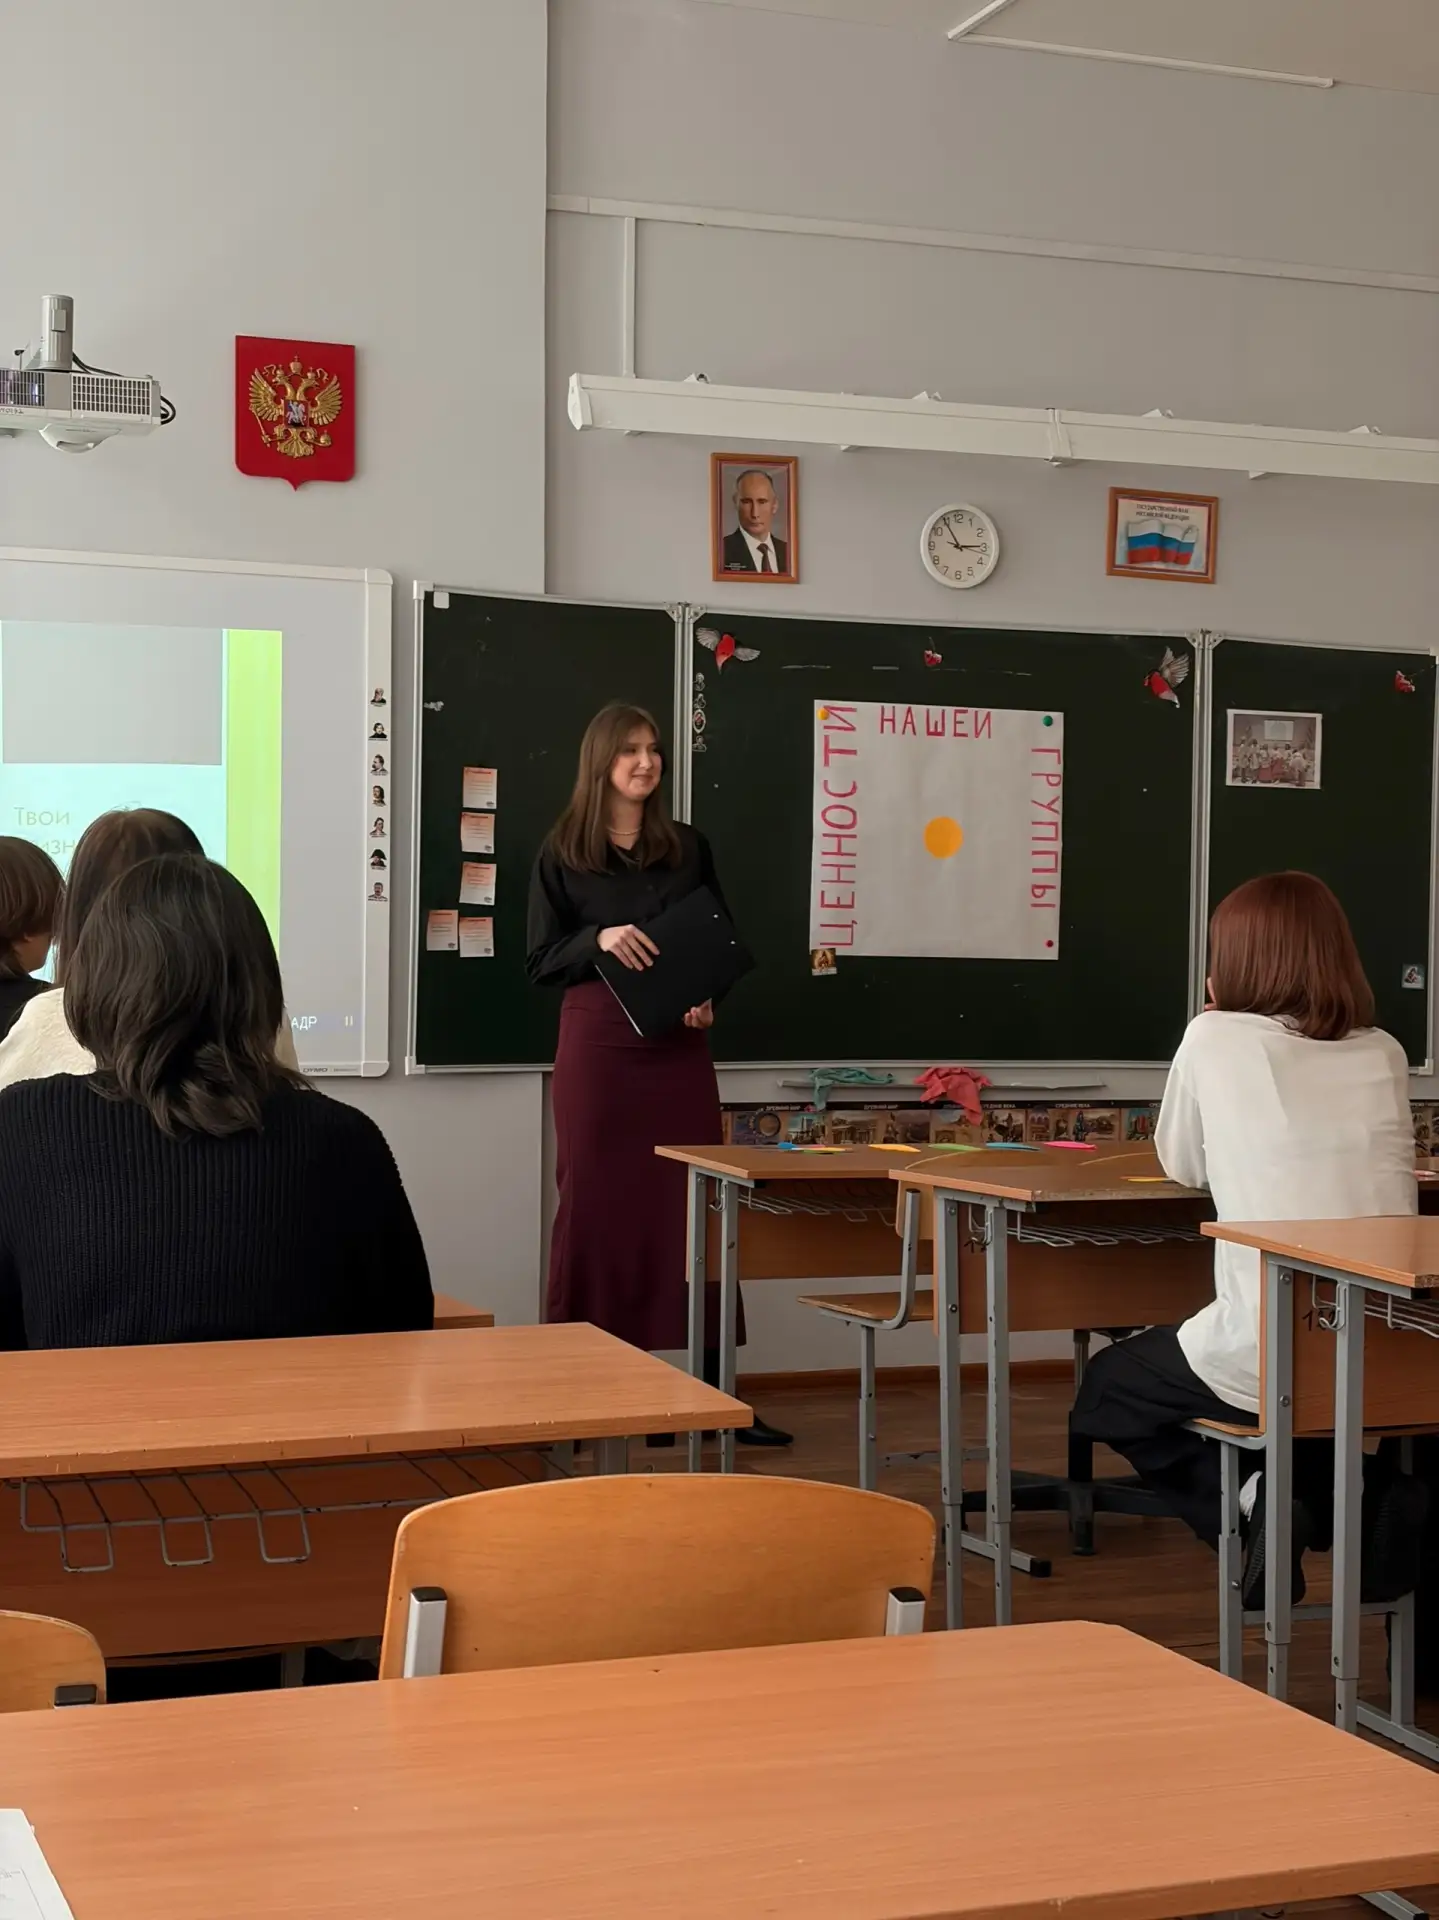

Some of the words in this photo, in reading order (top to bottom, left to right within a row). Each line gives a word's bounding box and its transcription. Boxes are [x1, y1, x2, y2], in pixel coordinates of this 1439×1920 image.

[953, 513, 964, 524] 12
[968, 518, 973, 528] 1
[932, 526, 943, 537] 10
[976, 527, 984, 538] 2
[928, 541, 936, 551] 9
[980, 542, 988, 552] 3
[932, 555, 940, 565] 8
[976, 556, 984, 566] 4
[943, 566, 949, 576] 7
[954, 570, 962, 580] 6
[967, 566, 974, 576] 5
[819, 705, 858, 946] ЦЕННОСТИ
[1030, 747, 1062, 908] ГРУППЫ
[291, 1015, 318, 1031] АДР
